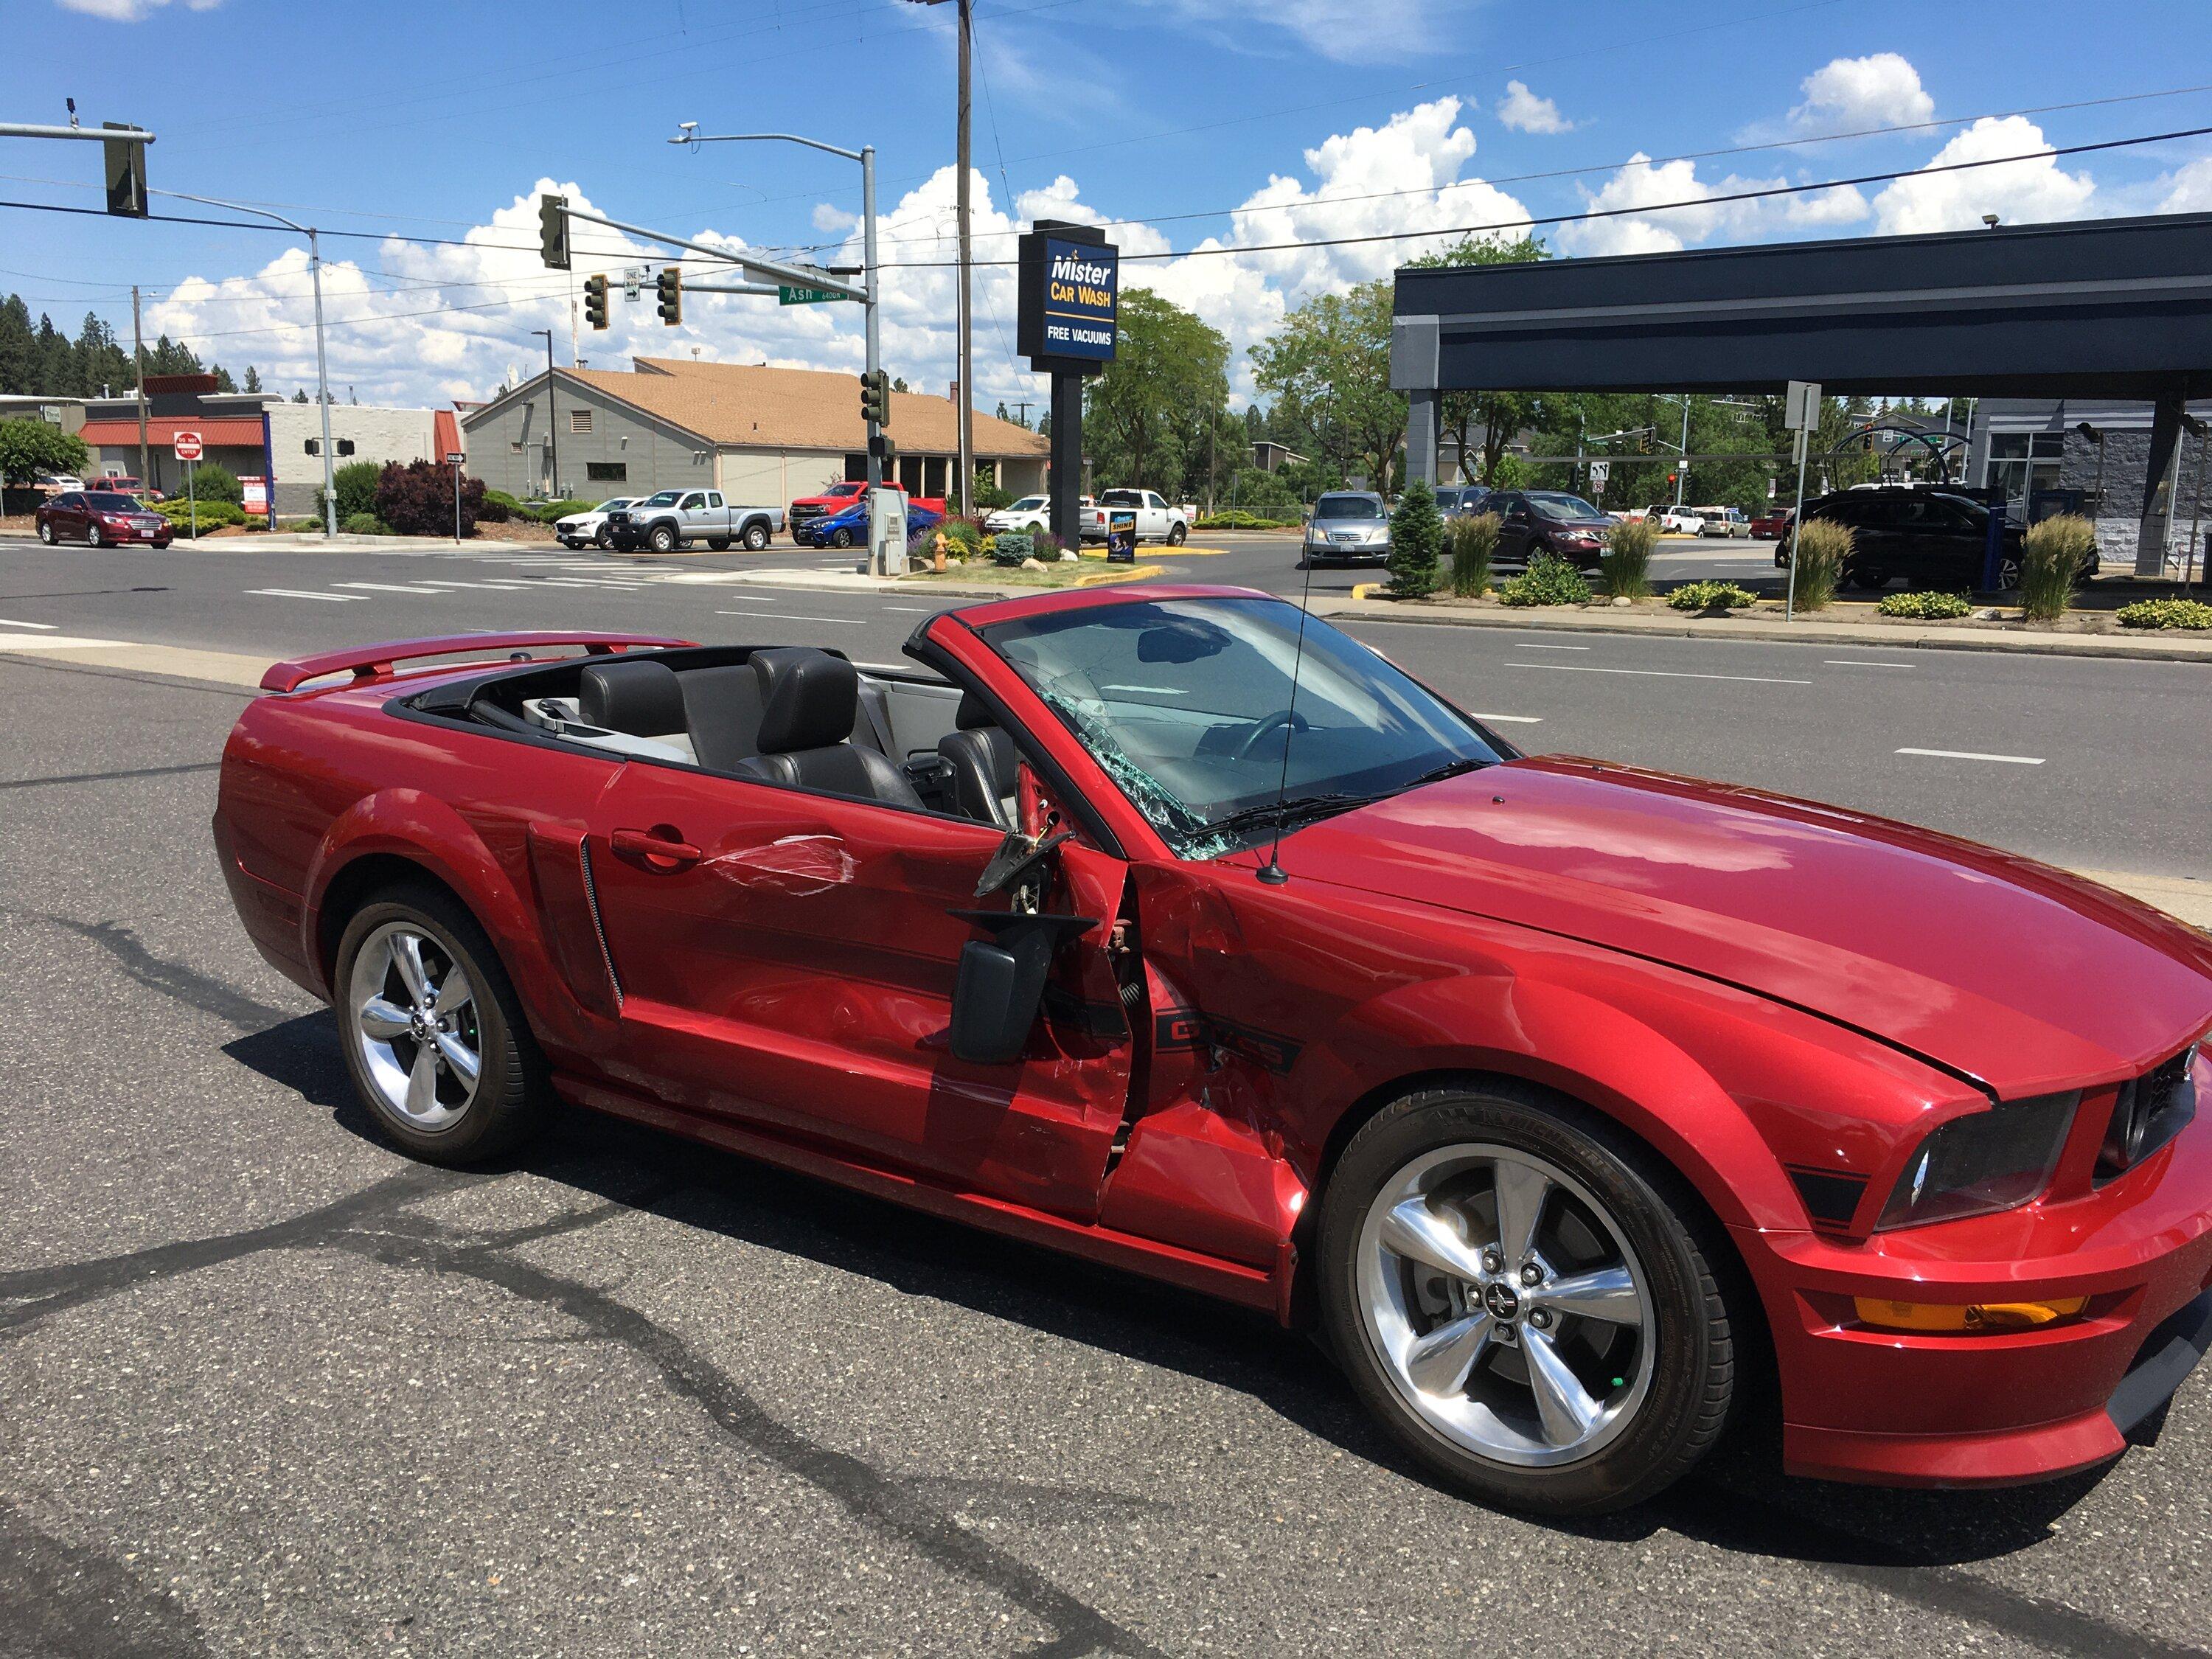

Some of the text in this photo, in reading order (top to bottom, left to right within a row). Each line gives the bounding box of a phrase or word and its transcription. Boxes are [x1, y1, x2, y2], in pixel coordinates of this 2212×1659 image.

[626, 271, 637, 279] ONE
[1051, 255, 1111, 285] Mister
[1051, 282, 1110, 307] CAR WASH
[1048, 325, 1111, 346] FREE VACUUMS
[1113, 521, 1133, 530] SHINE
